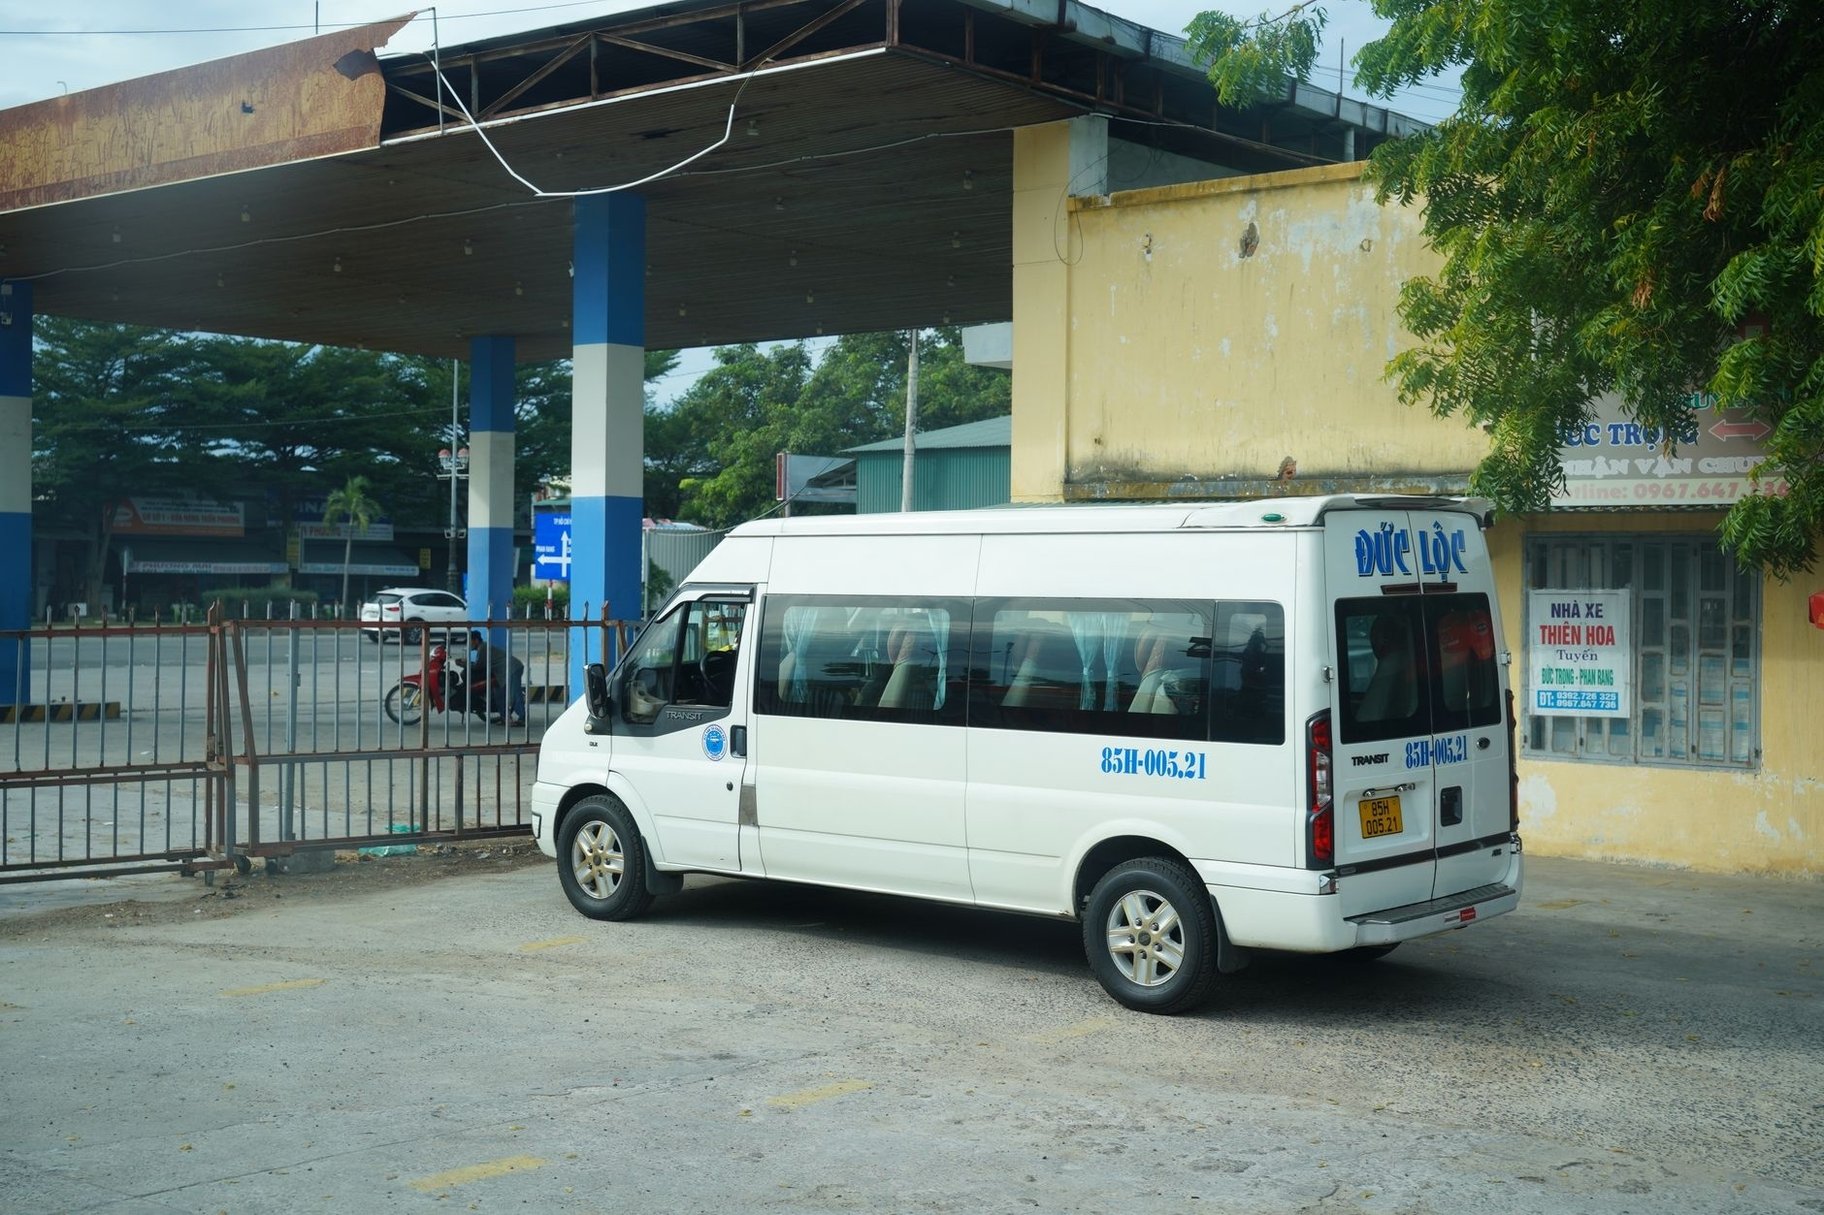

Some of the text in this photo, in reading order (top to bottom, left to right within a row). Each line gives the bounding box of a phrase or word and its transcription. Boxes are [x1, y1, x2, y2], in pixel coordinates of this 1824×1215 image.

[1418, 520, 1468, 583] LỘC
[1551, 600, 1603, 619] NHÀ XE
[1540, 621, 1615, 646] THIÊN HOA
[1556, 648, 1598, 663] Tuyến
[665, 710, 703, 720] TRANSIT
[1351, 753, 1390, 767] TRANSIT
[1405, 735, 1468, 769] 85H-005.21
[1101, 746, 1207, 780] 85H-005.21
[1371, 801, 1390, 817] 85H
[1366, 817, 1399, 836] 005.21
